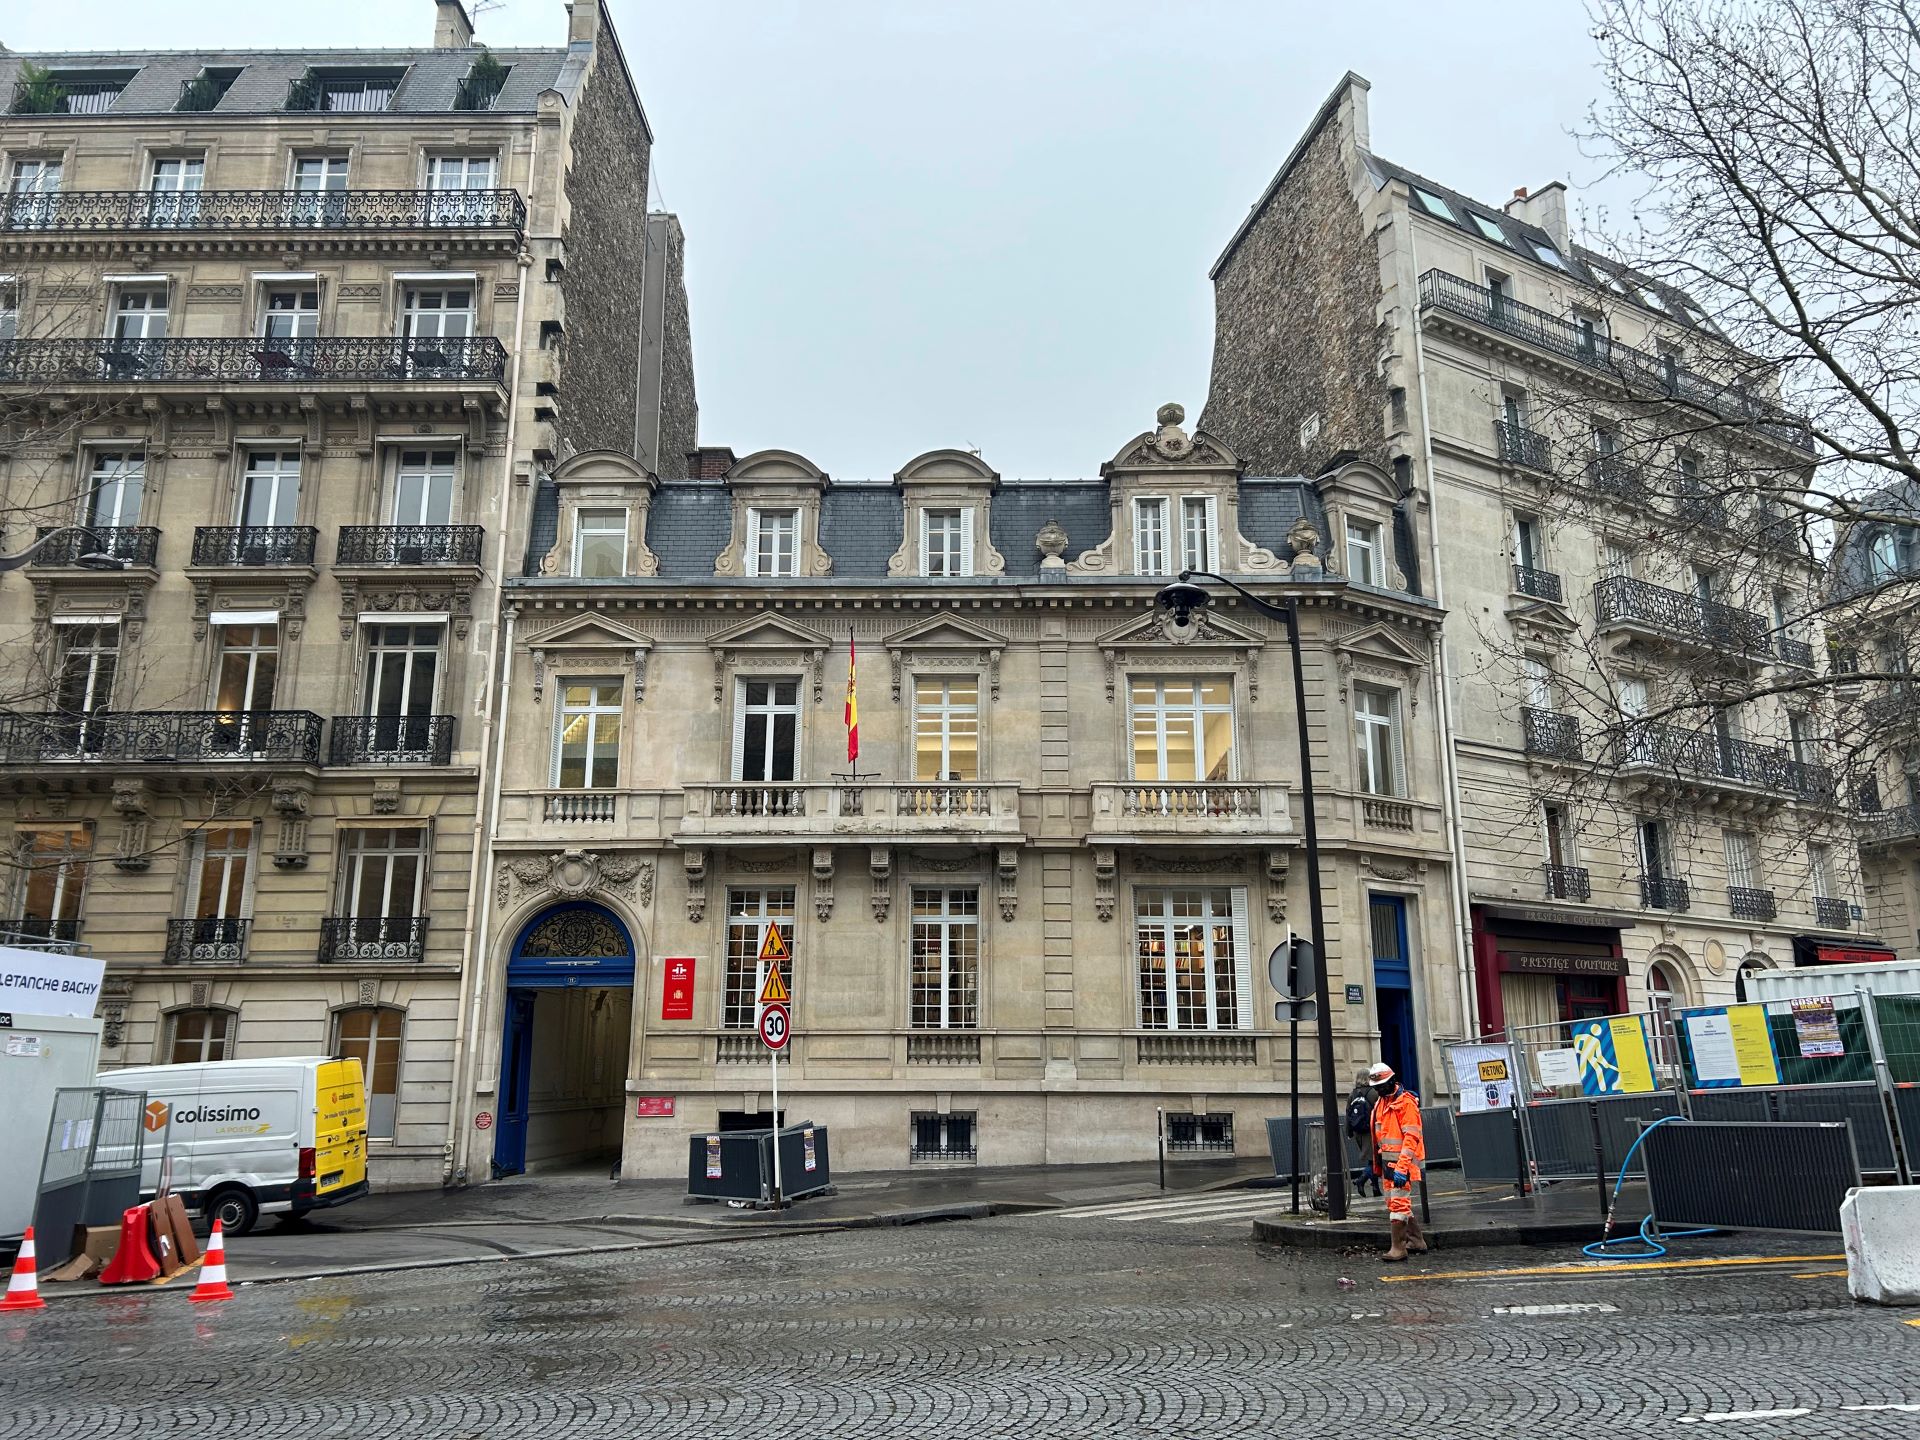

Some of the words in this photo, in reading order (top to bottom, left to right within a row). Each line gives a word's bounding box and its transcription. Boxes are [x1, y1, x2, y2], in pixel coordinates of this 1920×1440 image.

[1525, 912, 1567, 924] PRESTIGE
[1573, 915, 1612, 926] COUTURE
[1521, 957, 1569, 971] PRESTIGE
[1575, 959, 1619, 971] COUTURE
[61, 980, 98, 995] BACHY
[1791, 996, 1832, 1006] GOSPEL
[766, 1016, 784, 1036] 30
[175, 1105, 260, 1123] colissimo
[227, 1125, 255, 1133] POSTE
